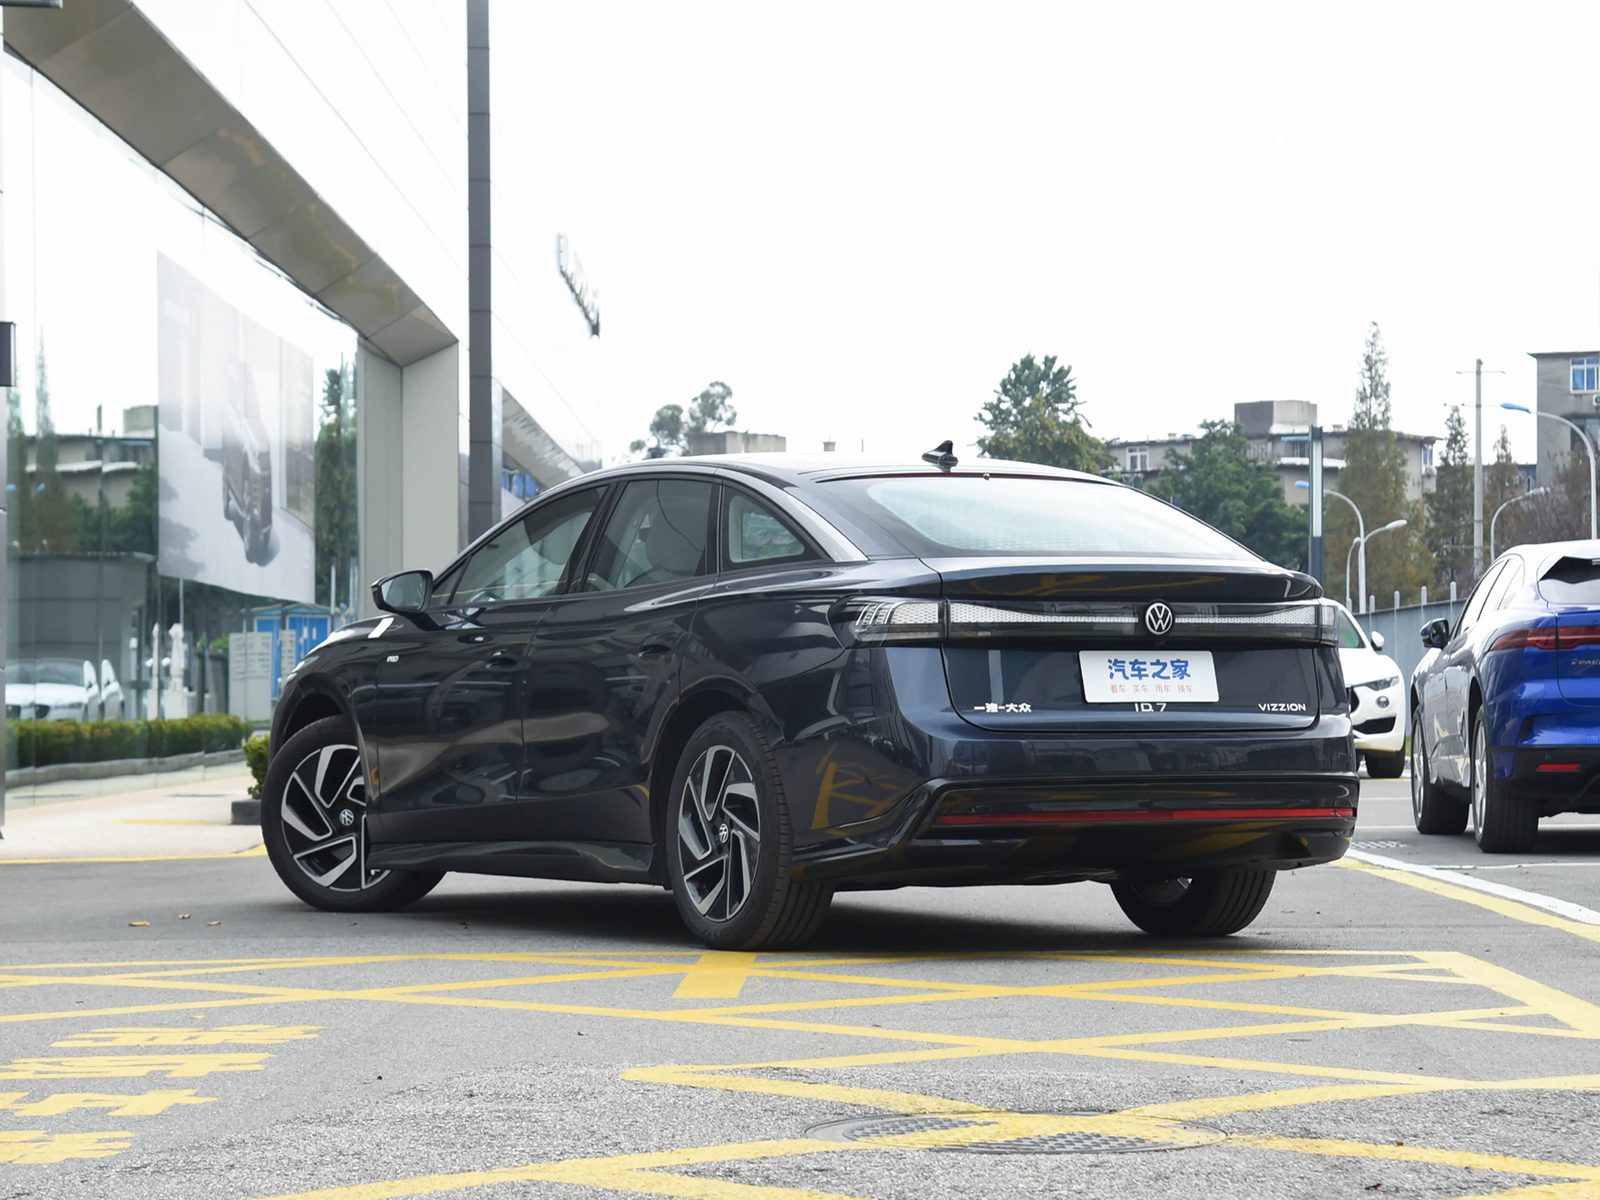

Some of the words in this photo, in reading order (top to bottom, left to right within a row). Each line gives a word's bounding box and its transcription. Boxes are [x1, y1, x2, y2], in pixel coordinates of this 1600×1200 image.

[1108, 658, 1191, 681] 汽车之家
[1258, 703, 1306, 711] VIZZION
